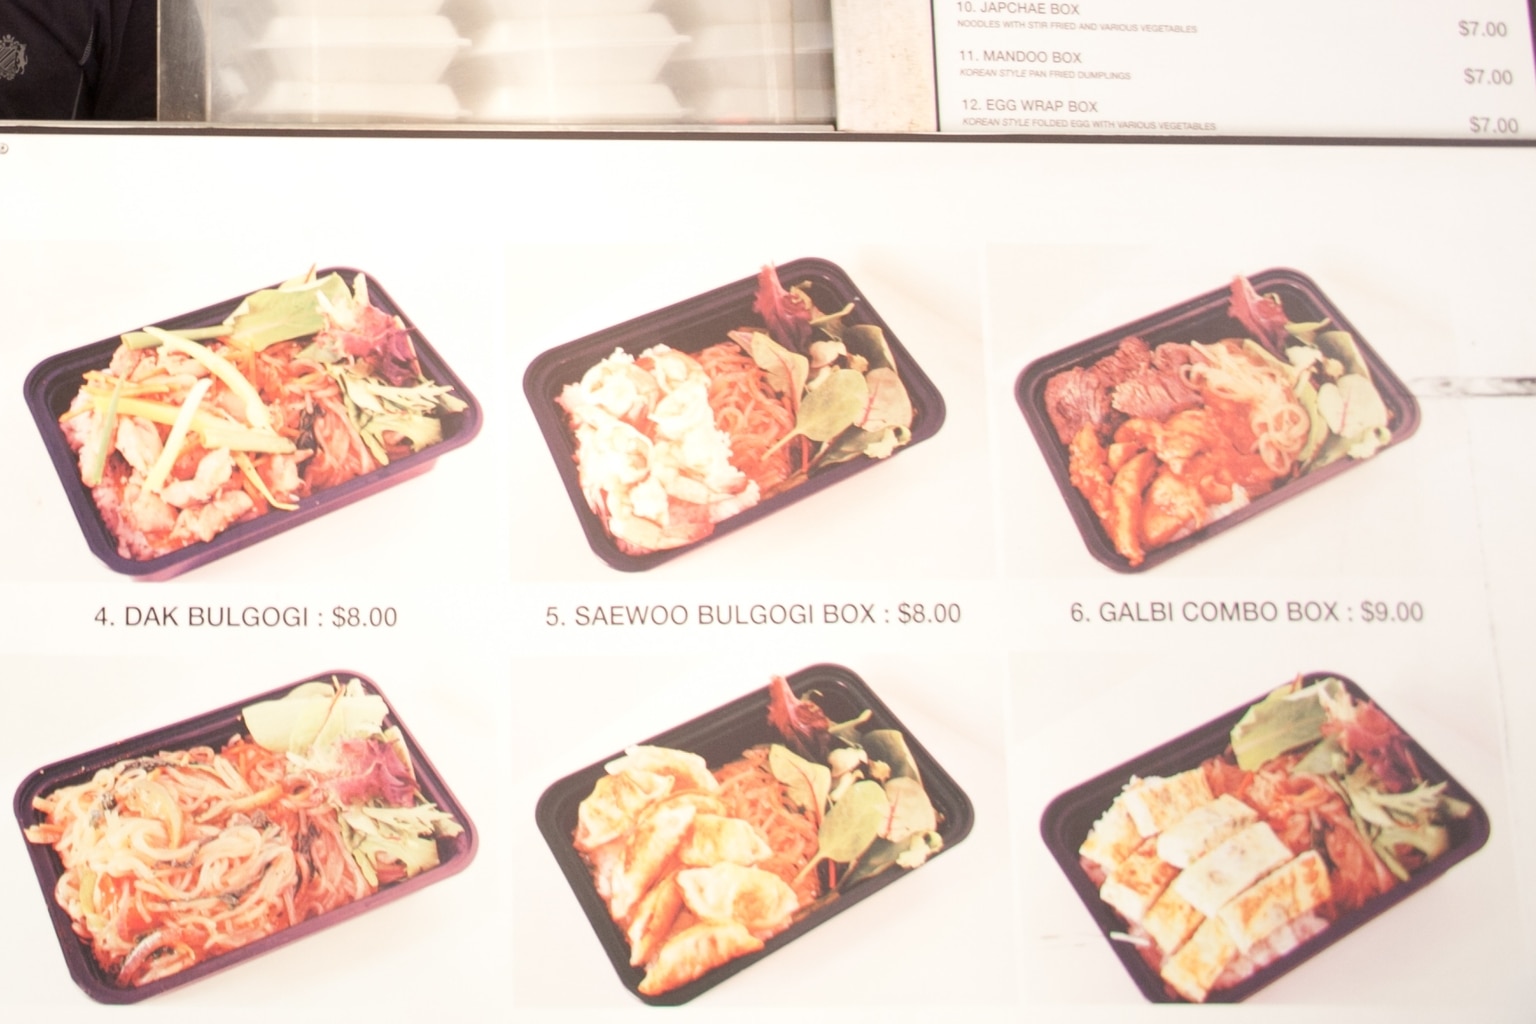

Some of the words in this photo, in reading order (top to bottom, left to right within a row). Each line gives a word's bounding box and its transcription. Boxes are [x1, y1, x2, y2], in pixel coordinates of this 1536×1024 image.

[1458, 20, 1508, 37] $7.00
[962, 98, 981, 111] 12.
[986, 99, 1017, 111] EGG
[1020, 99, 1064, 112] WRAP
[1068, 100, 1098, 113] BOX
[94, 607, 114, 626] 4.
[125, 606, 178, 626] DAK
[189, 606, 307, 627] BULGOGI
[332, 606, 397, 628] $8.00
[546, 606, 565, 626] 5.
[575, 605, 688, 626] SAEWOO
[698, 604, 813, 625] BULGOGI
[823, 603, 876, 624] BOX
[898, 602, 961, 624] $8.00
[1071, 602, 1090, 623] 6.
[1099, 601, 1173, 622] GALBI
[1182, 601, 1278, 622] COMBO
[1287, 601, 1340, 622] BOX
[1361, 600, 1424, 623] $9.00
